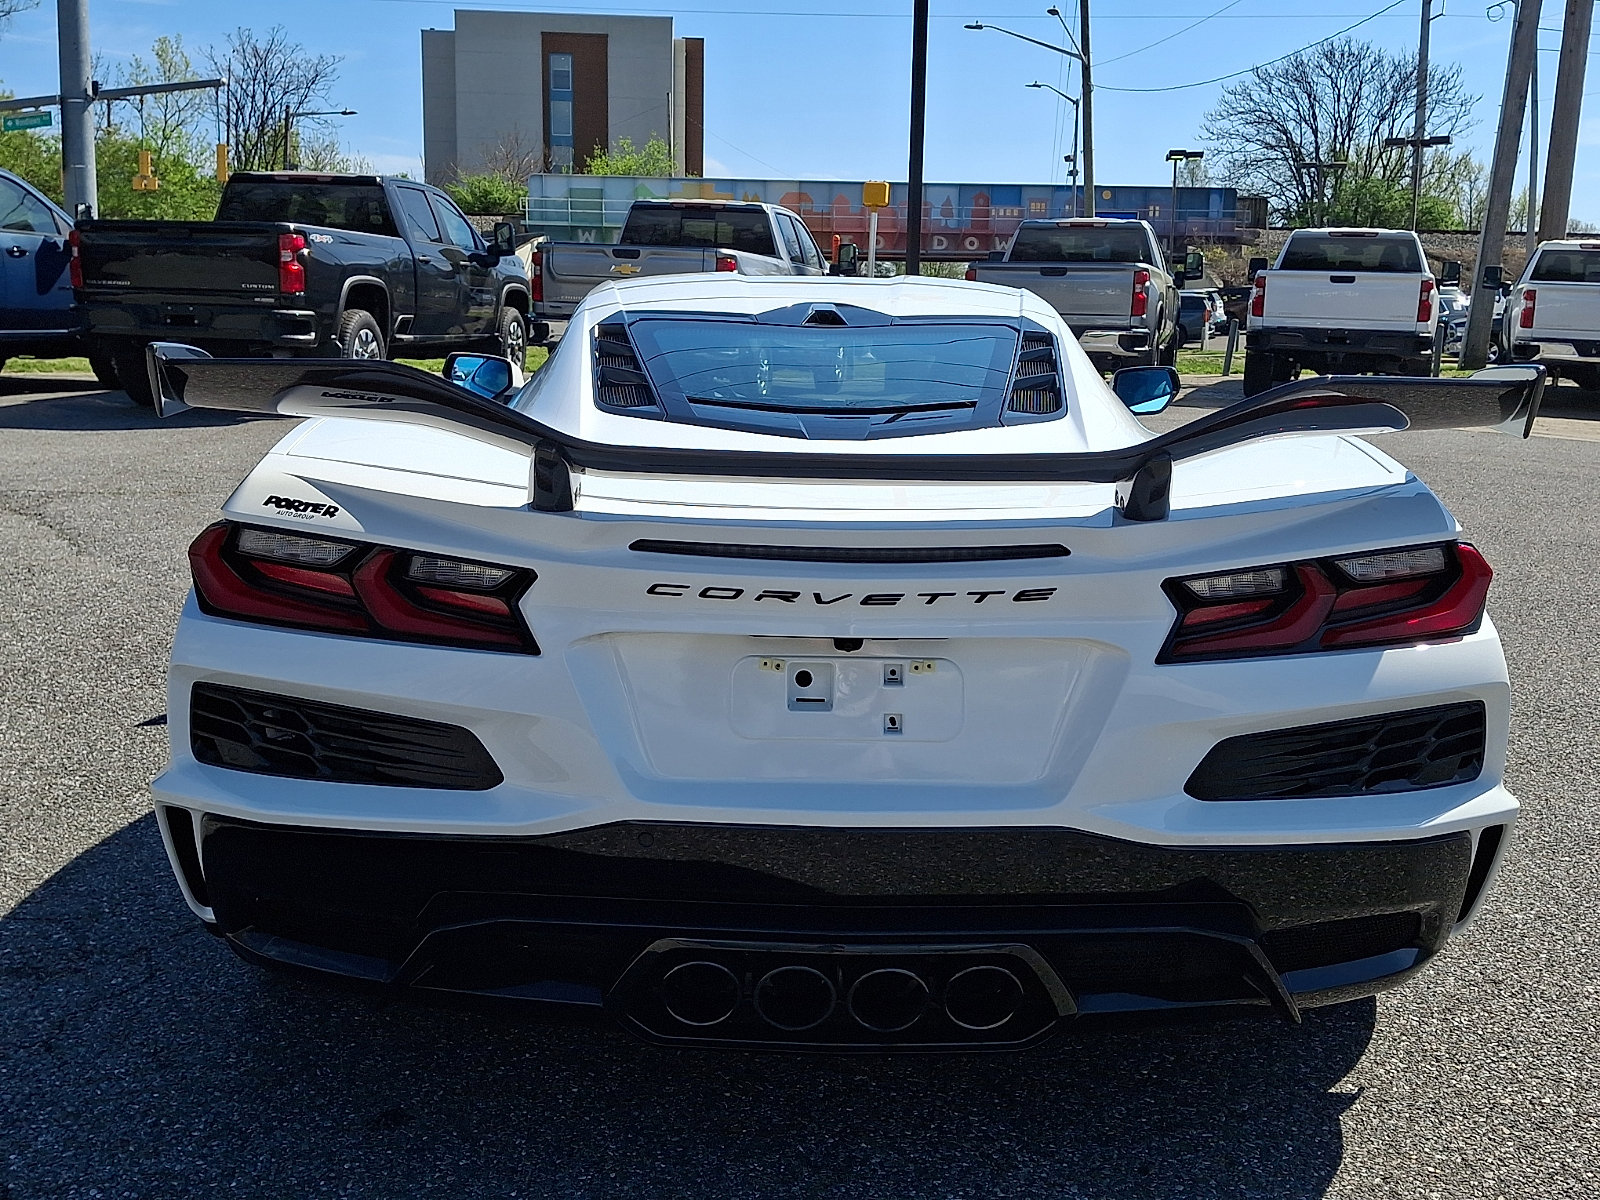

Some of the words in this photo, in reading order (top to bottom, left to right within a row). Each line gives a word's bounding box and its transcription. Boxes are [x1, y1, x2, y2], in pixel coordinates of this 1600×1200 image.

[262, 495, 340, 518] PORTER
[293, 512, 315, 520] GROUP
[646, 583, 1057, 605] CORVETTE
